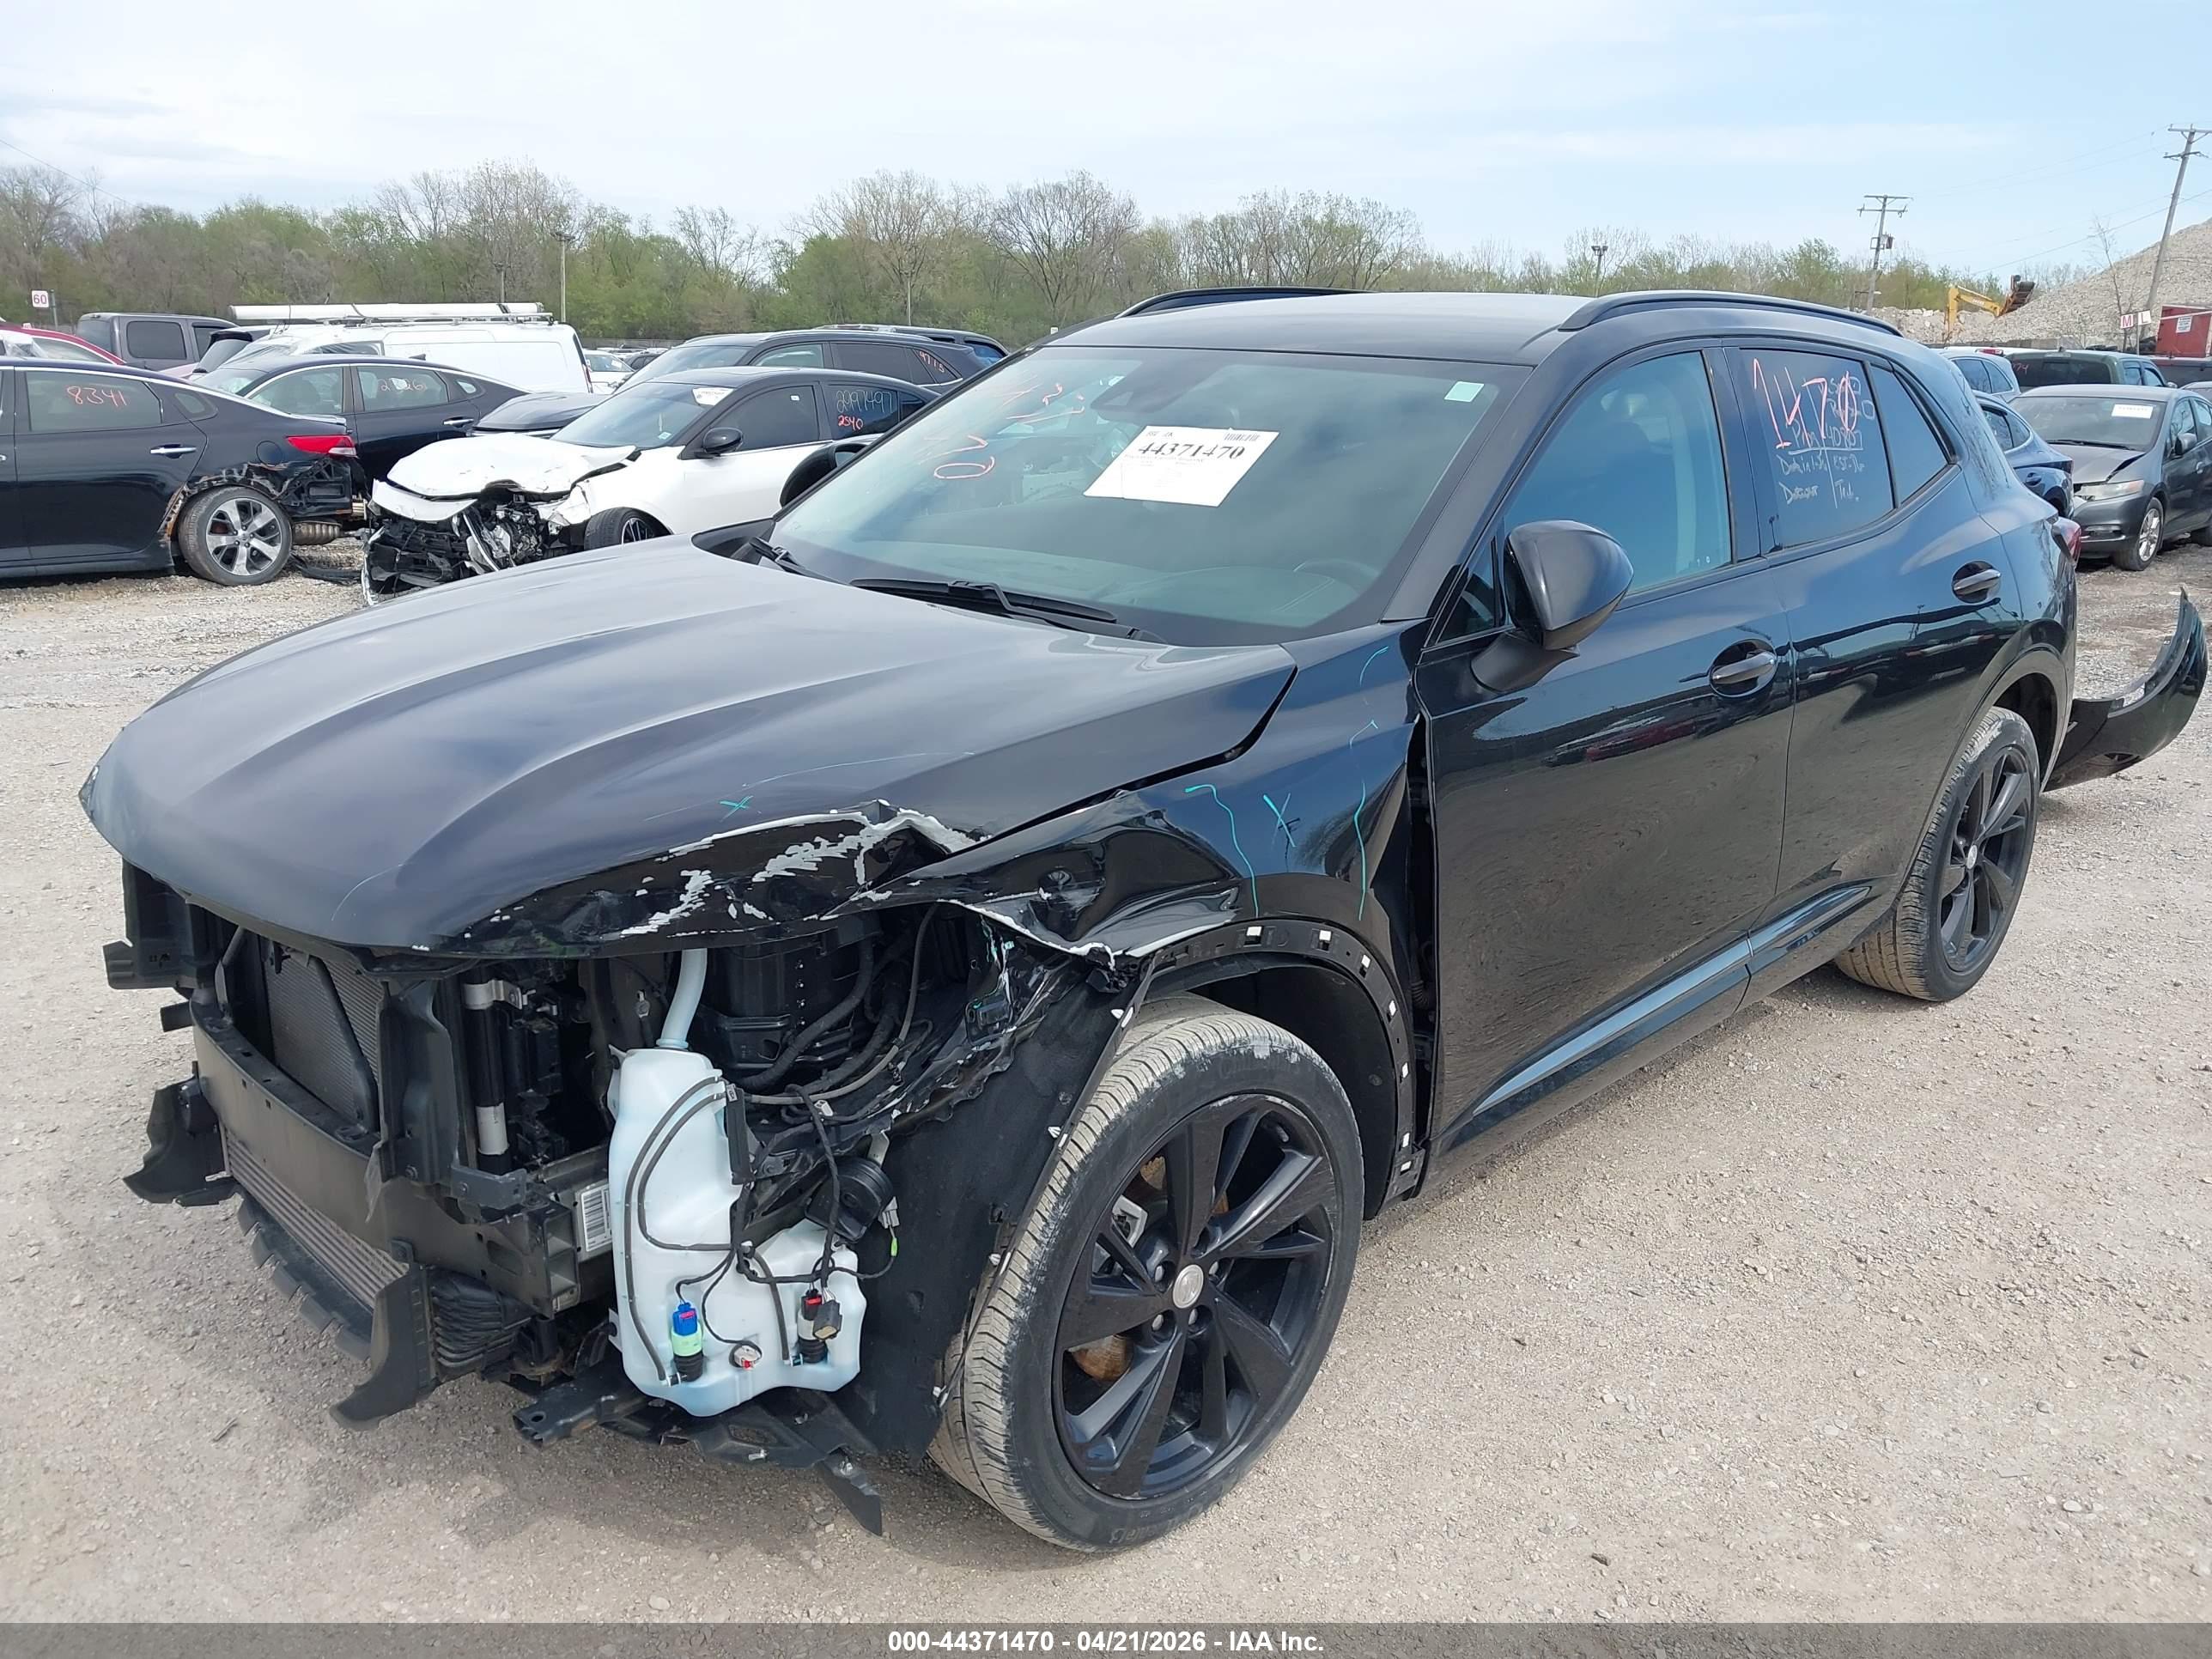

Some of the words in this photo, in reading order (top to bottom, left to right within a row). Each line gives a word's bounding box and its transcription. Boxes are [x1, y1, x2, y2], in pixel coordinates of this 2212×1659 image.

[33, 294, 47, 305] 60
[2122, 314, 2131, 327] M
[2141, 312, 2150, 324] L
[67, 386, 128, 406] 8341
[1753, 357, 1857, 449] 1470
[838, 415, 864, 430] 2540
[1139, 442, 1245, 459] 44371470
